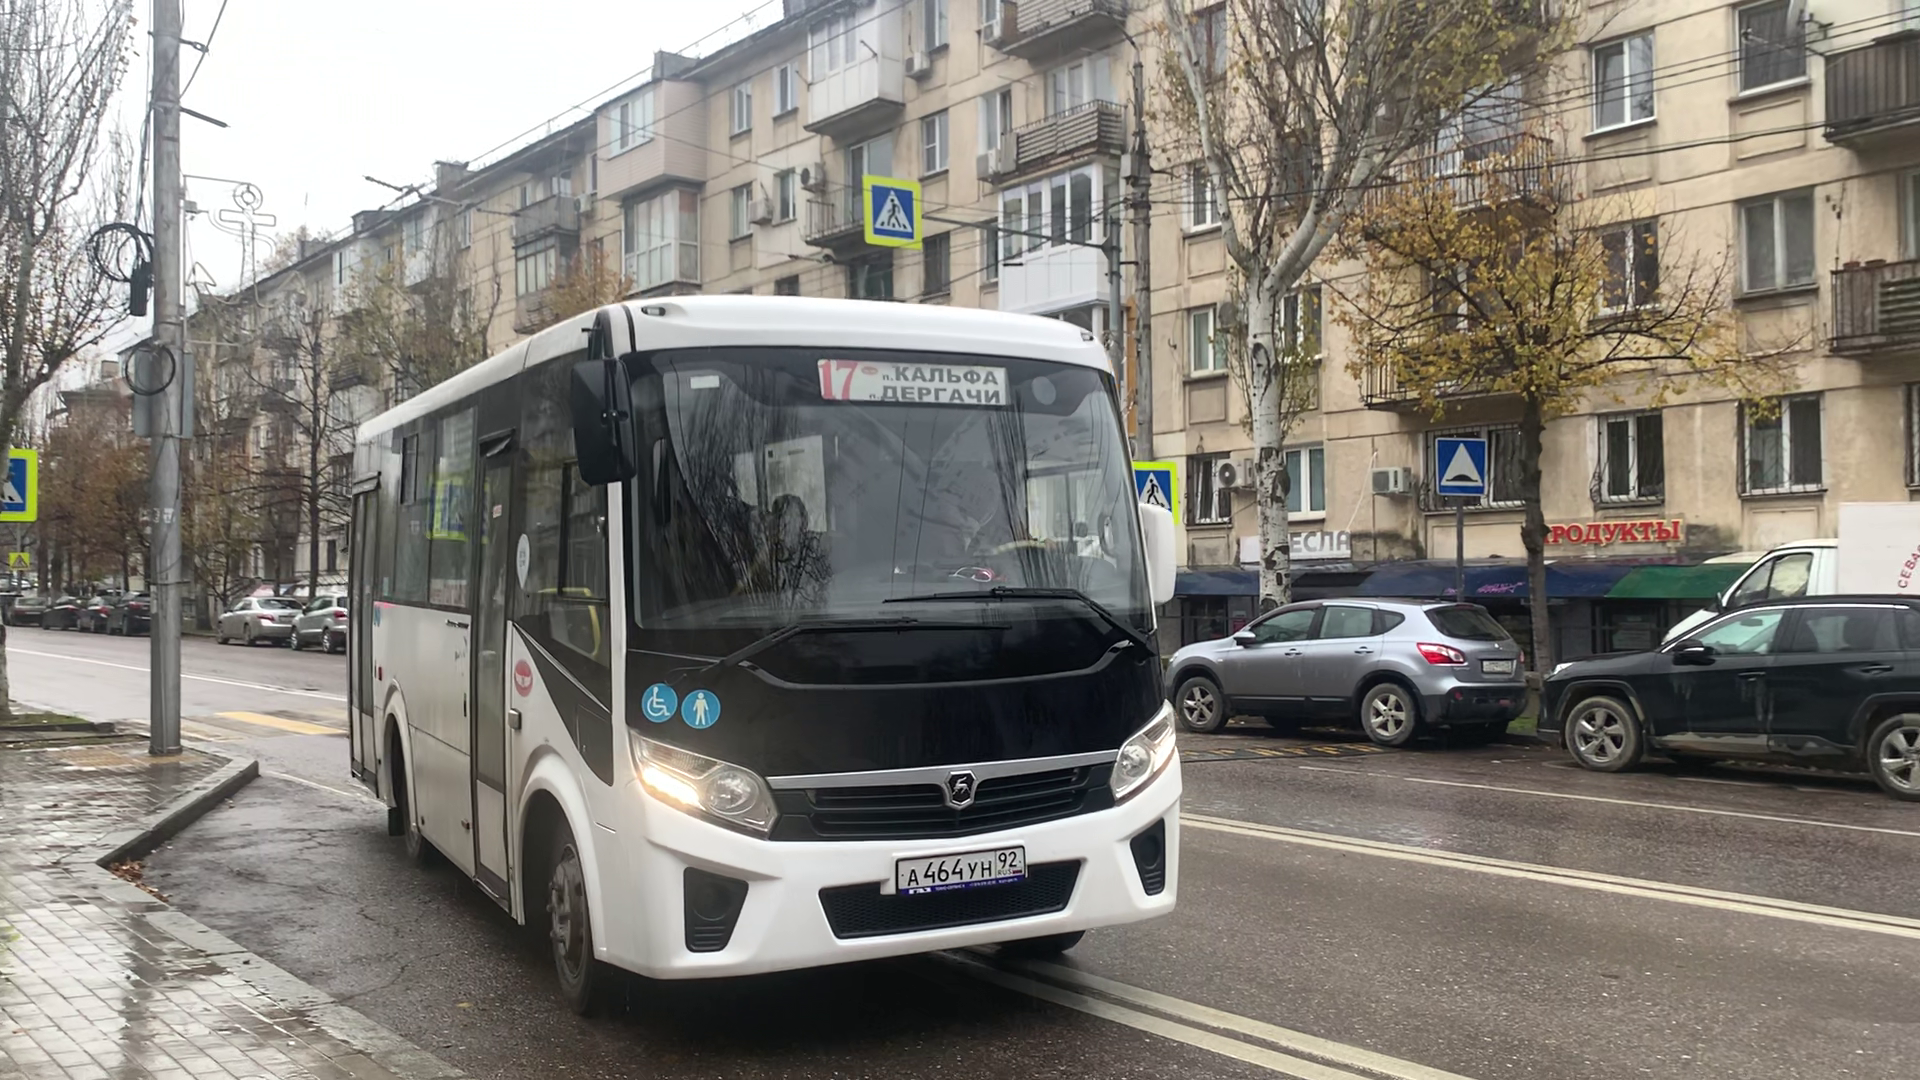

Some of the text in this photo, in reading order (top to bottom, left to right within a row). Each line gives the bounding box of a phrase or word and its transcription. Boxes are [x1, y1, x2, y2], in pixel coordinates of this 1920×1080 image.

[818, 360, 859, 400] 17
[1289, 531, 1351, 553] ЕСЛА
[907, 858, 992, 886] А464УН
[998, 851, 1017, 869] 92
